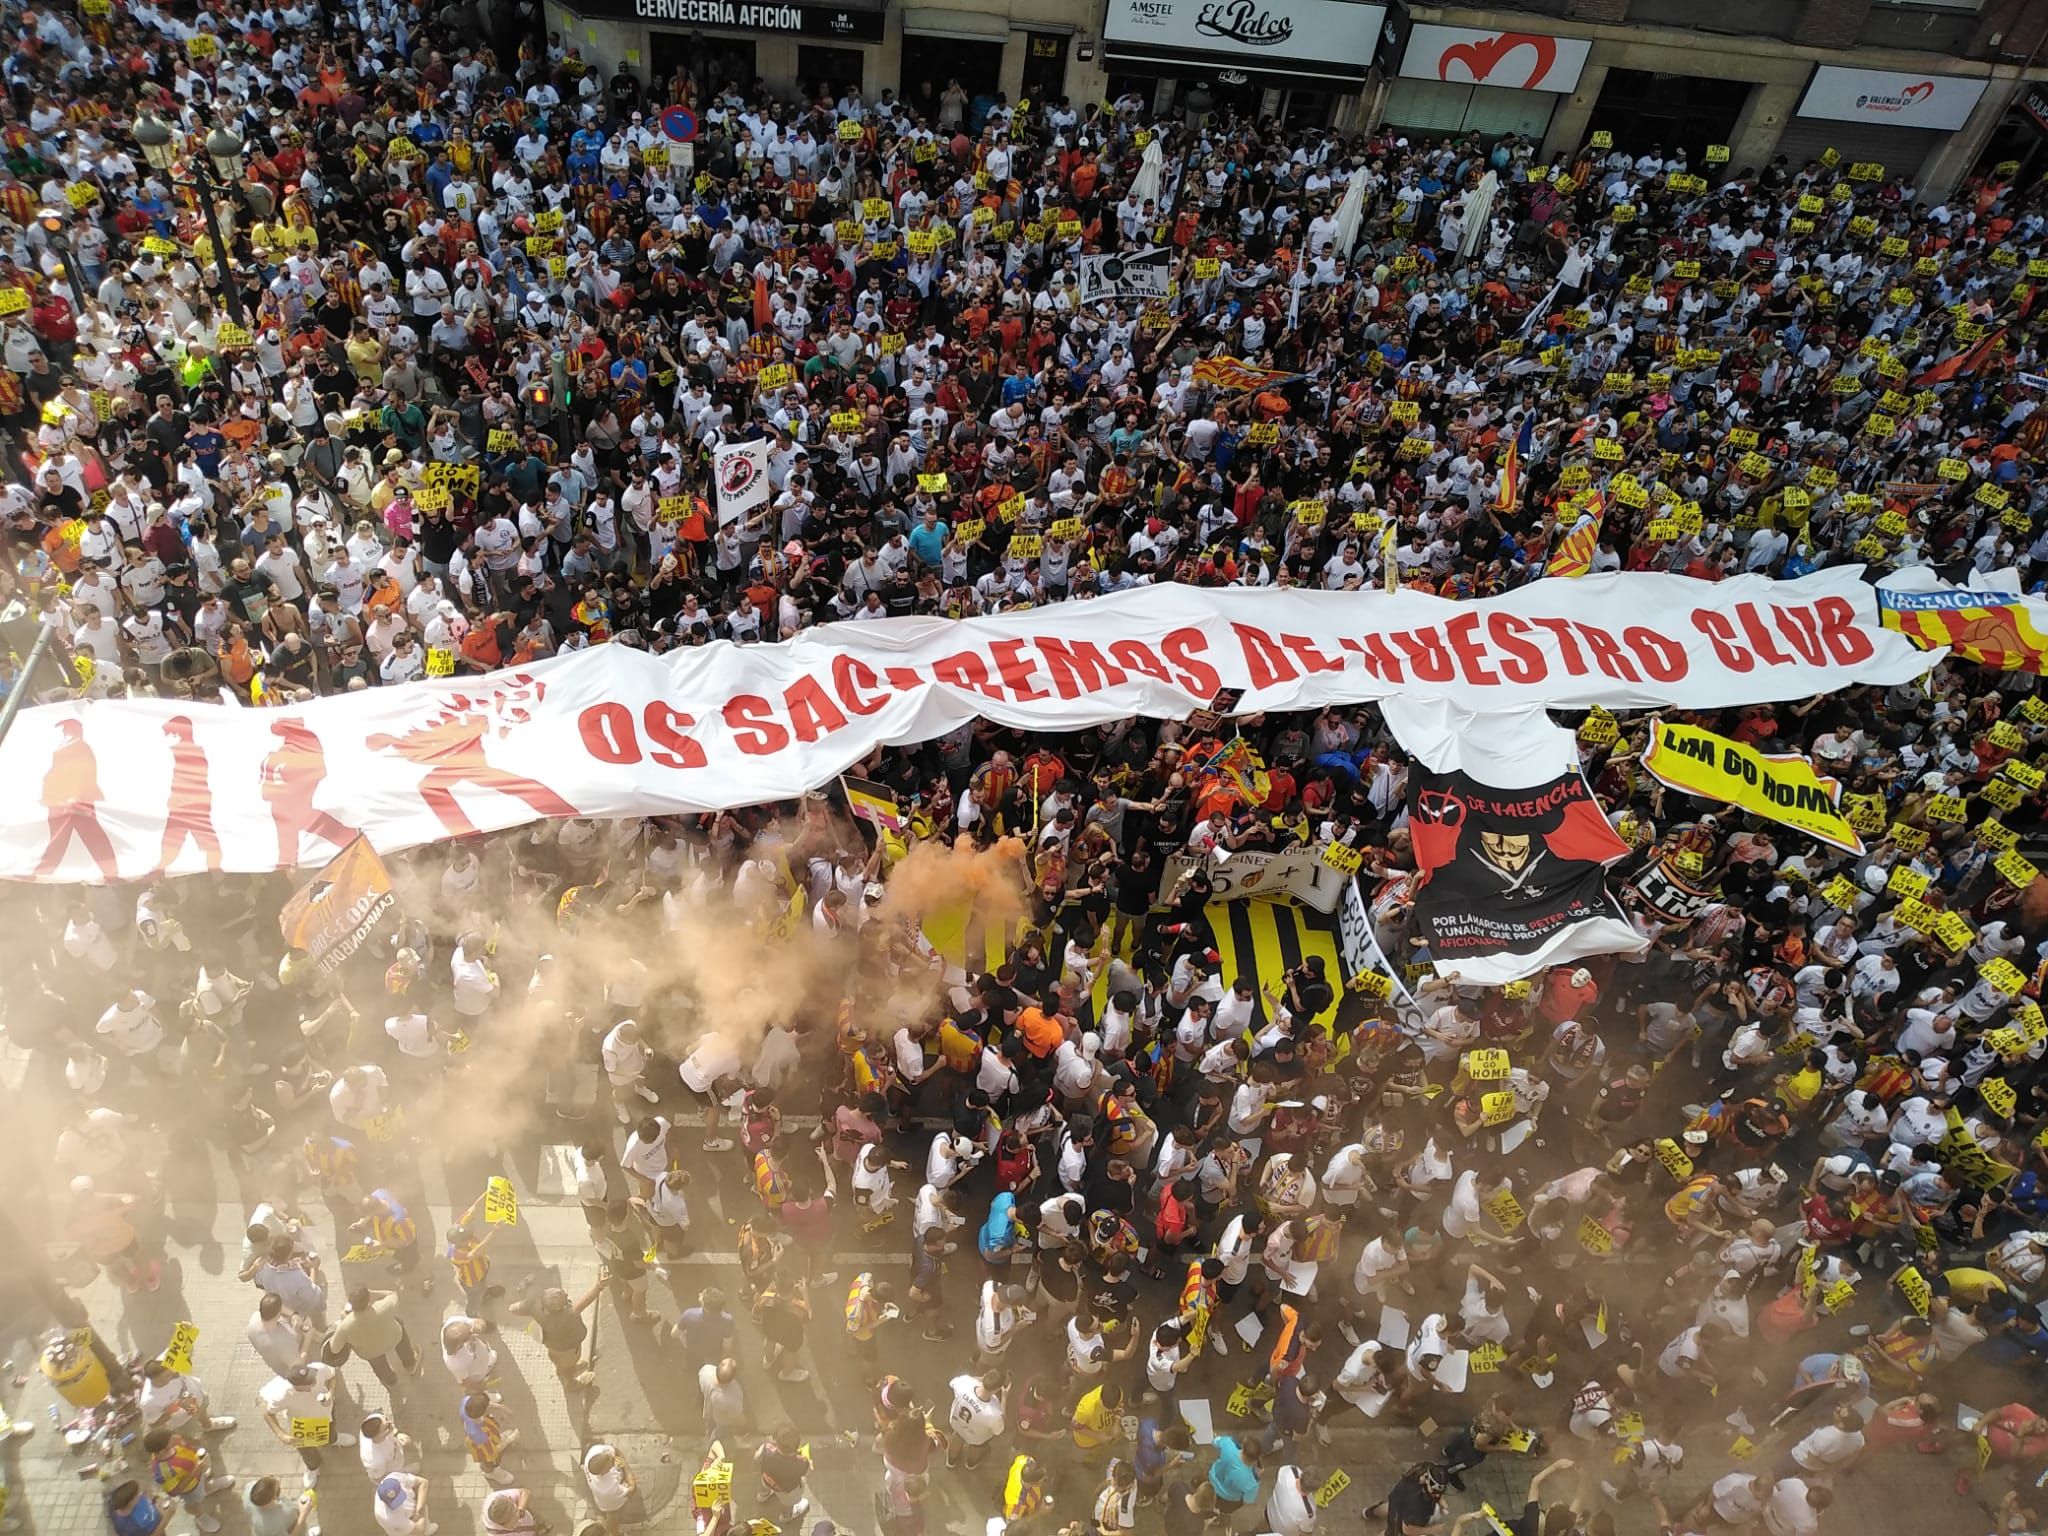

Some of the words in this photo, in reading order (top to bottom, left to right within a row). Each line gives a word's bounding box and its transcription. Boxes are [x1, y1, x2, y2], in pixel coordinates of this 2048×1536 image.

[1129, 2, 1173, 15] AMSTEL
[635, 0, 736, 24] CERVECERÍA
[739, 6, 802, 30] AFICIÓN
[1198, 3, 1224, 31] El
[1227, 0, 1293, 35] Palco
[831, 20, 854, 30] TURIA
[1870, 95, 1901, 105] VALENCIA
[540, 214, 556, 222] LIM
[865, 210, 888, 218] HOME
[540, 223, 563, 232] HOME
[532, 238, 548, 246] LIM
[909, 244, 933, 252] HOME
[1125, 263, 1153, 272] FUERA
[1120, 287, 1168, 297] MESTALLA
[1962, 323, 1978, 331] LIM
[1954, 332, 1977, 340] HOME
[764, 366, 780, 376] LIM
[762, 376, 786, 387] HOME
[1256, 424, 1273, 432] LIM
[1735, 430, 1752, 438] LIM
[494, 432, 512, 441] LIM
[1409, 440, 1427, 448] LIM
[738, 450, 757, 458] VCF
[1402, 450, 1427, 458] HOME
[1749, 454, 1766, 465] LIM
[1738, 462, 1764, 475] HOME
[1947, 460, 1964, 468] LIM
[434, 469, 458, 477] GO
[1940, 471, 1965, 480] HOME
[421, 489, 441, 499] LIM
[1626, 484, 1643, 494] LIM
[1988, 486, 2004, 496] LIM
[419, 500, 449, 510] HOME
[666, 497, 684, 507] LIM
[1004, 496, 1020, 509] LIM
[1618, 494, 1643, 507] HOME
[1978, 495, 2002, 508] HOME
[662, 509, 689, 520] HOME
[1302, 514, 1318, 522] LIM
[1682, 511, 1698, 521] LIM
[67, 521, 83, 536] LIM
[962, 521, 979, 530] LIM
[1057, 520, 1075, 529] LIM
[1016, 536, 1035, 544] LIM
[1054, 530, 1080, 539] HOME
[1011, 549, 1038, 557] HOME
[1884, 592, 2001, 609] VALENCIA
[436, 649, 452, 658] LIM
[428, 665, 453, 673] HOME
[1592, 720, 1613, 729] LIM
[578, 701, 708, 769] OS
[1582, 732, 1615, 742] HOME
[1663, 729, 1715, 768] LIM
[1723, 748, 1757, 786] GO
[2008, 767, 2040, 787] HOME
[1996, 783, 2017, 795] LIM
[1466, 795, 1490, 814] DE
[1491, 780, 1584, 818] VALENCIA
[1938, 795, 1960, 805] LIM
[1984, 792, 2013, 808] HOME
[1929, 808, 1963, 820] HOME
[1900, 827, 1922, 837] LIM
[1990, 822, 2011, 838] LIM
[1977, 830, 2010, 850] HOME
[1335, 846, 1357, 859] LIM
[1324, 855, 1356, 874] HOME
[2012, 855, 2032, 872] LIM
[1997, 860, 2026, 886] HOME
[1890, 881, 1922, 900] HOME
[1829, 894, 1845, 906] LIM
[1909, 900, 1932, 916] LIM
[1432, 915, 1457, 927] POR
[1459, 913, 1473, 924] LA
[1512, 923, 1528, 932] DE
[1529, 911, 1566, 930] PETER
[1435, 928, 1444, 938] Y
[1445, 927, 1473, 937] UNA
[1490, 930, 1512, 940] QUE
[1567, 907, 1591, 917] LOS
[1899, 911, 1932, 934] HOME
[1950, 915, 1969, 936] LIM
[1934, 921, 1959, 950] HOME
[1998, 962, 2022, 979] LIM
[1362, 972, 1384, 988] LIM
[1982, 970, 2016, 994] HOME
[2031, 1010, 2045, 1029] LIM
[2018, 1013, 2036, 1043] HOME
[2002, 1028, 2024, 1046] LIM
[1478, 1050, 1500, 1061] LIM
[1472, 1068, 1508, 1078] HOME
[1995, 1081, 2014, 1100] LIM
[1492, 1096, 1513, 1106] LIM
[1982, 1085, 2006, 1115] HOME
[1486, 1112, 1514, 1122] HOME
[1668, 1145, 1689, 1166] LIM
[488, 1186, 500, 1212] LIM
[498, 1194, 506, 1208] GO
[506, 1183, 514, 1224] HOME
[1504, 1198, 1523, 1218] LIM
[1486, 1200, 1512, 1230] HOME
[1583, 1218, 1610, 1242] HOME
[1899, 1280, 1924, 1313] HOME
[315, 1425, 327, 1442] LIM
[696, 1473, 708, 1498] LIM
[718, 1466, 730, 1502] HOME
